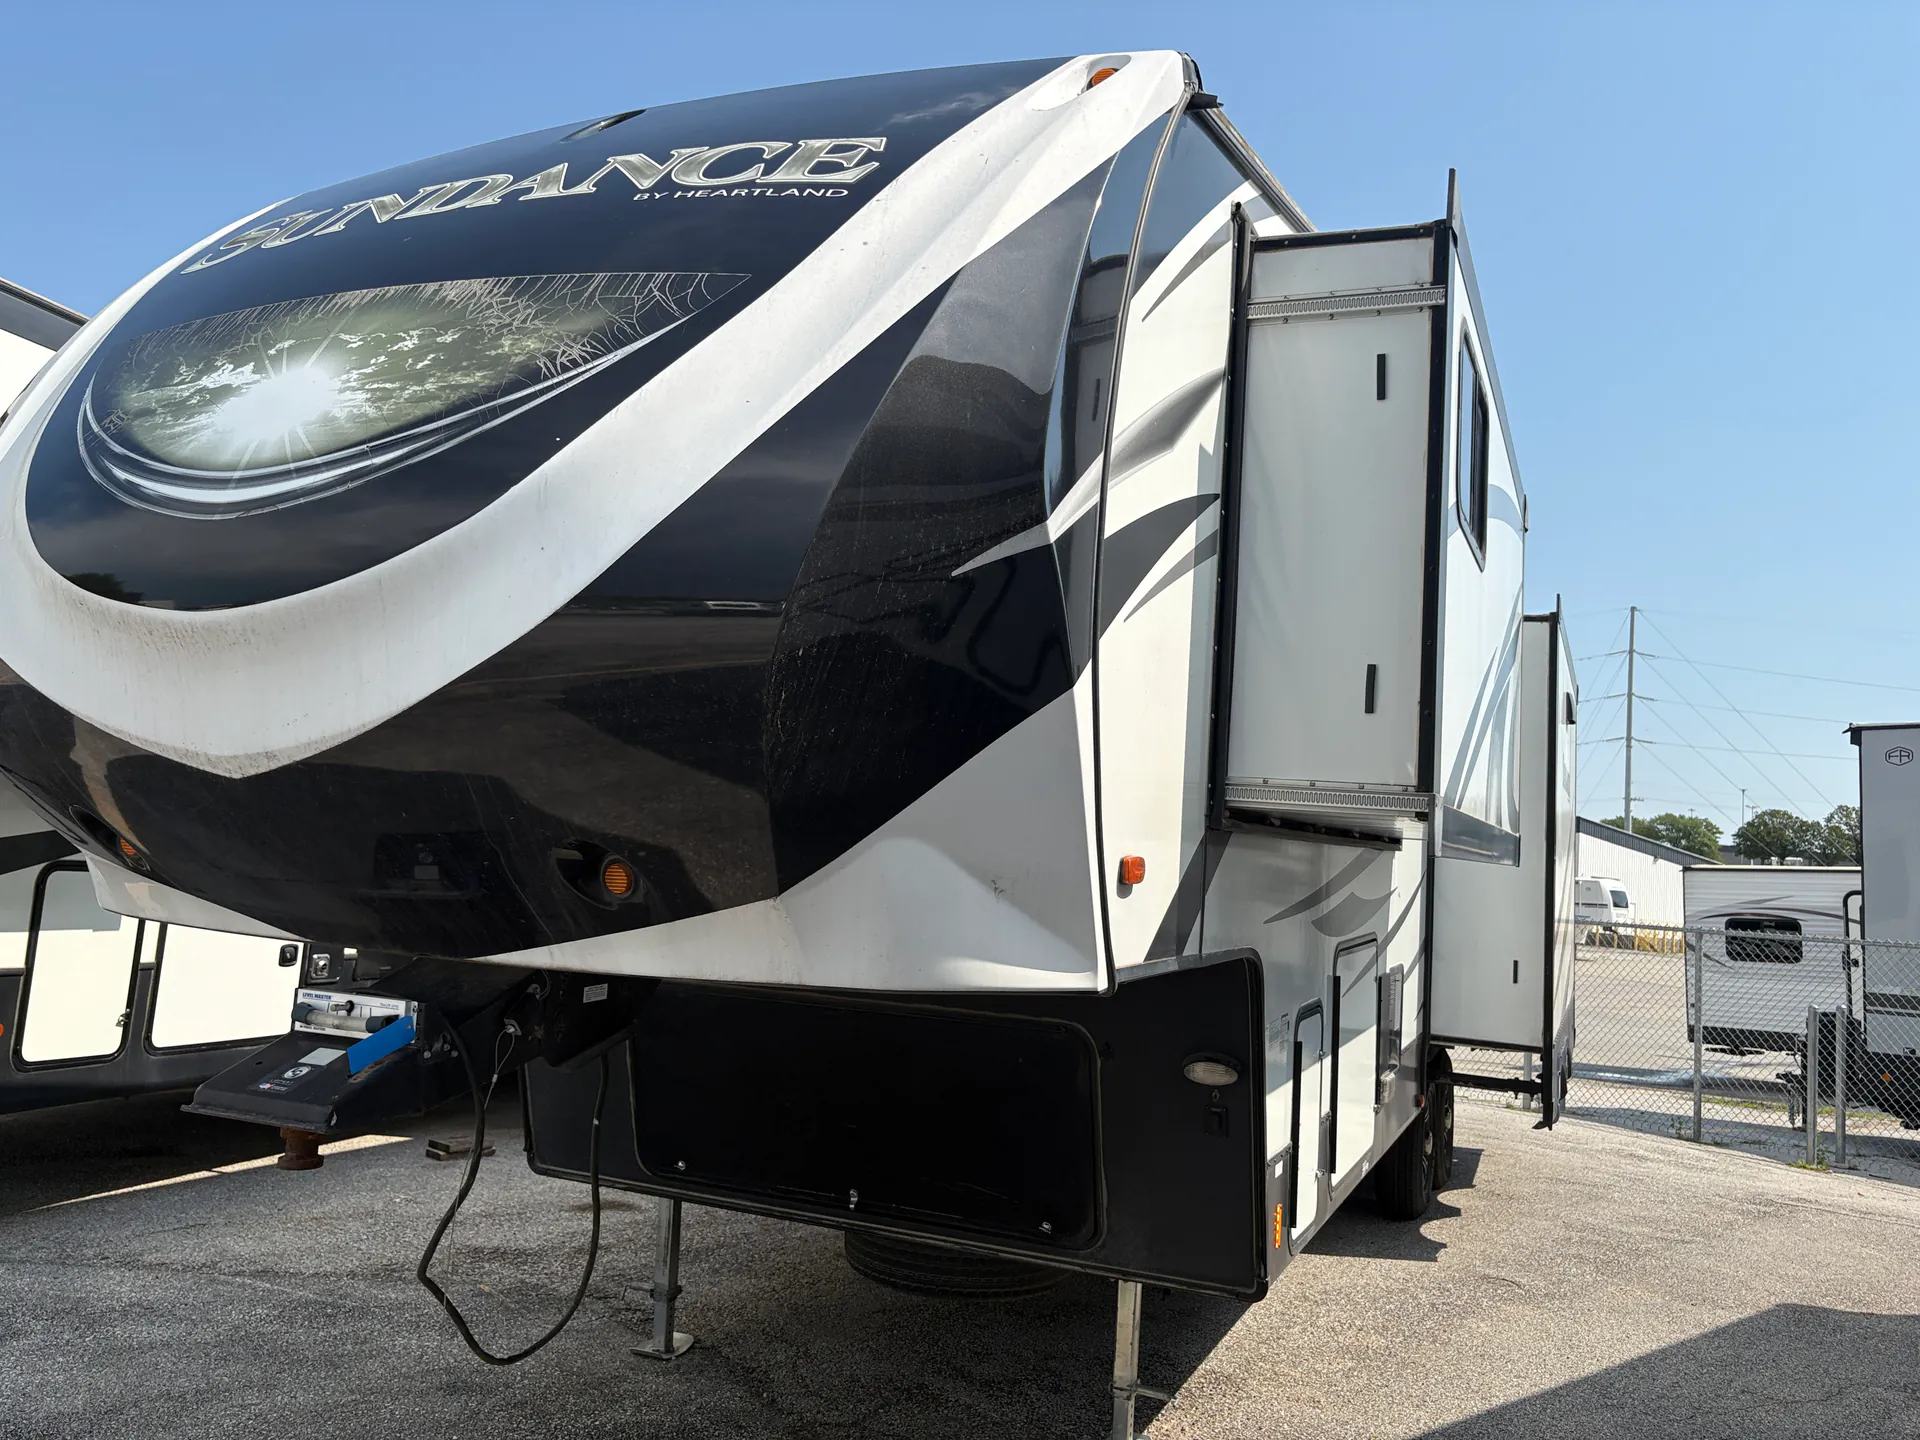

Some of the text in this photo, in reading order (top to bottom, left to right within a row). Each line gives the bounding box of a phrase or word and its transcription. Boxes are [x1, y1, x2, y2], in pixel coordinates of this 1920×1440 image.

[180, 137, 887, 275] SUNDANCE
[633, 187, 849, 201] BY HEARTLAND
